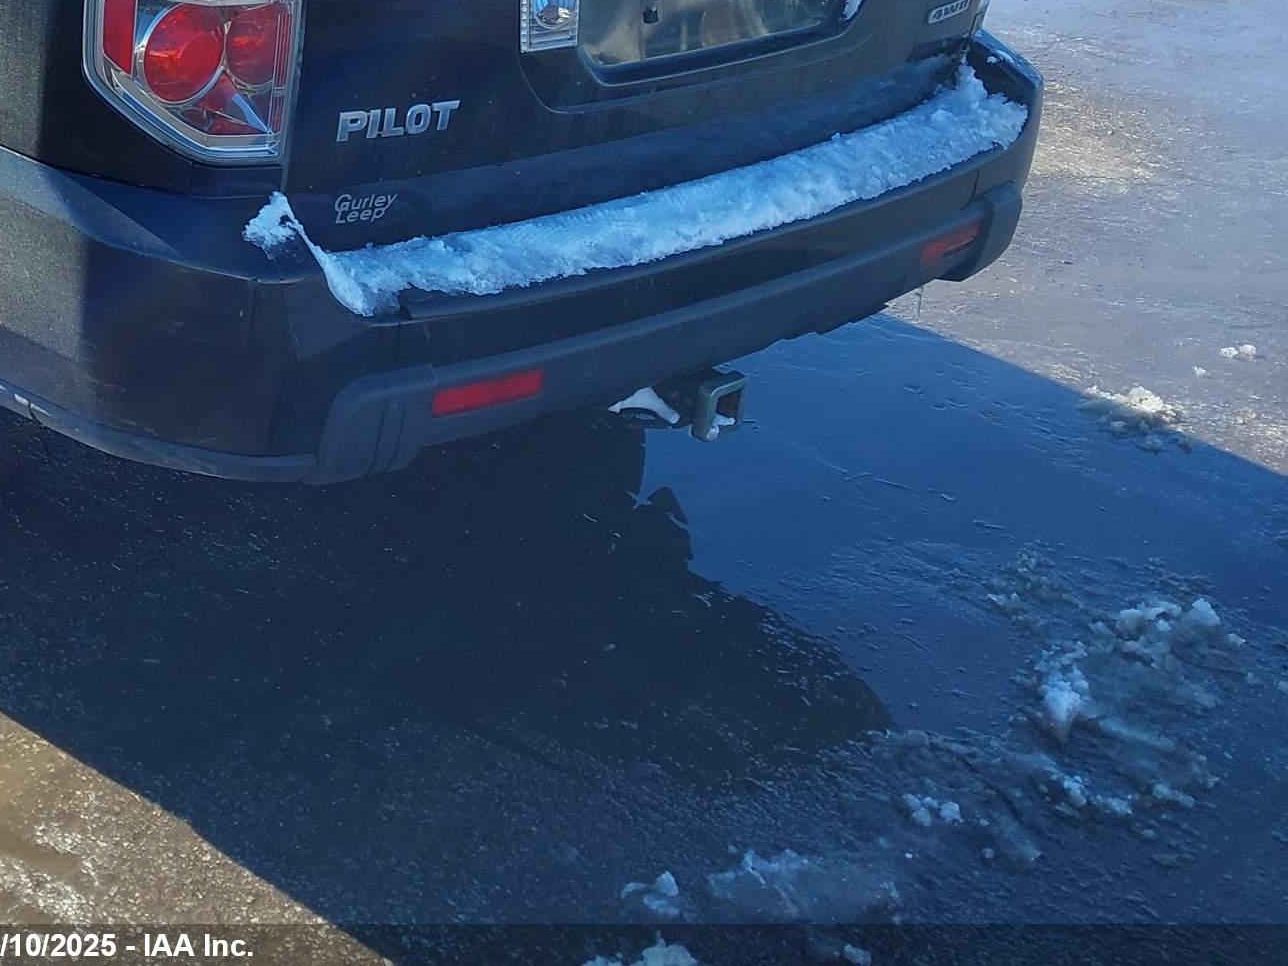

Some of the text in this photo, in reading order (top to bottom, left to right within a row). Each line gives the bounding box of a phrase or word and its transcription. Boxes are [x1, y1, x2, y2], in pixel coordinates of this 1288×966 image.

[336, 99, 460, 142] PILOT
[334, 192, 399, 217] Gurley
[334, 207, 387, 225] Leep
